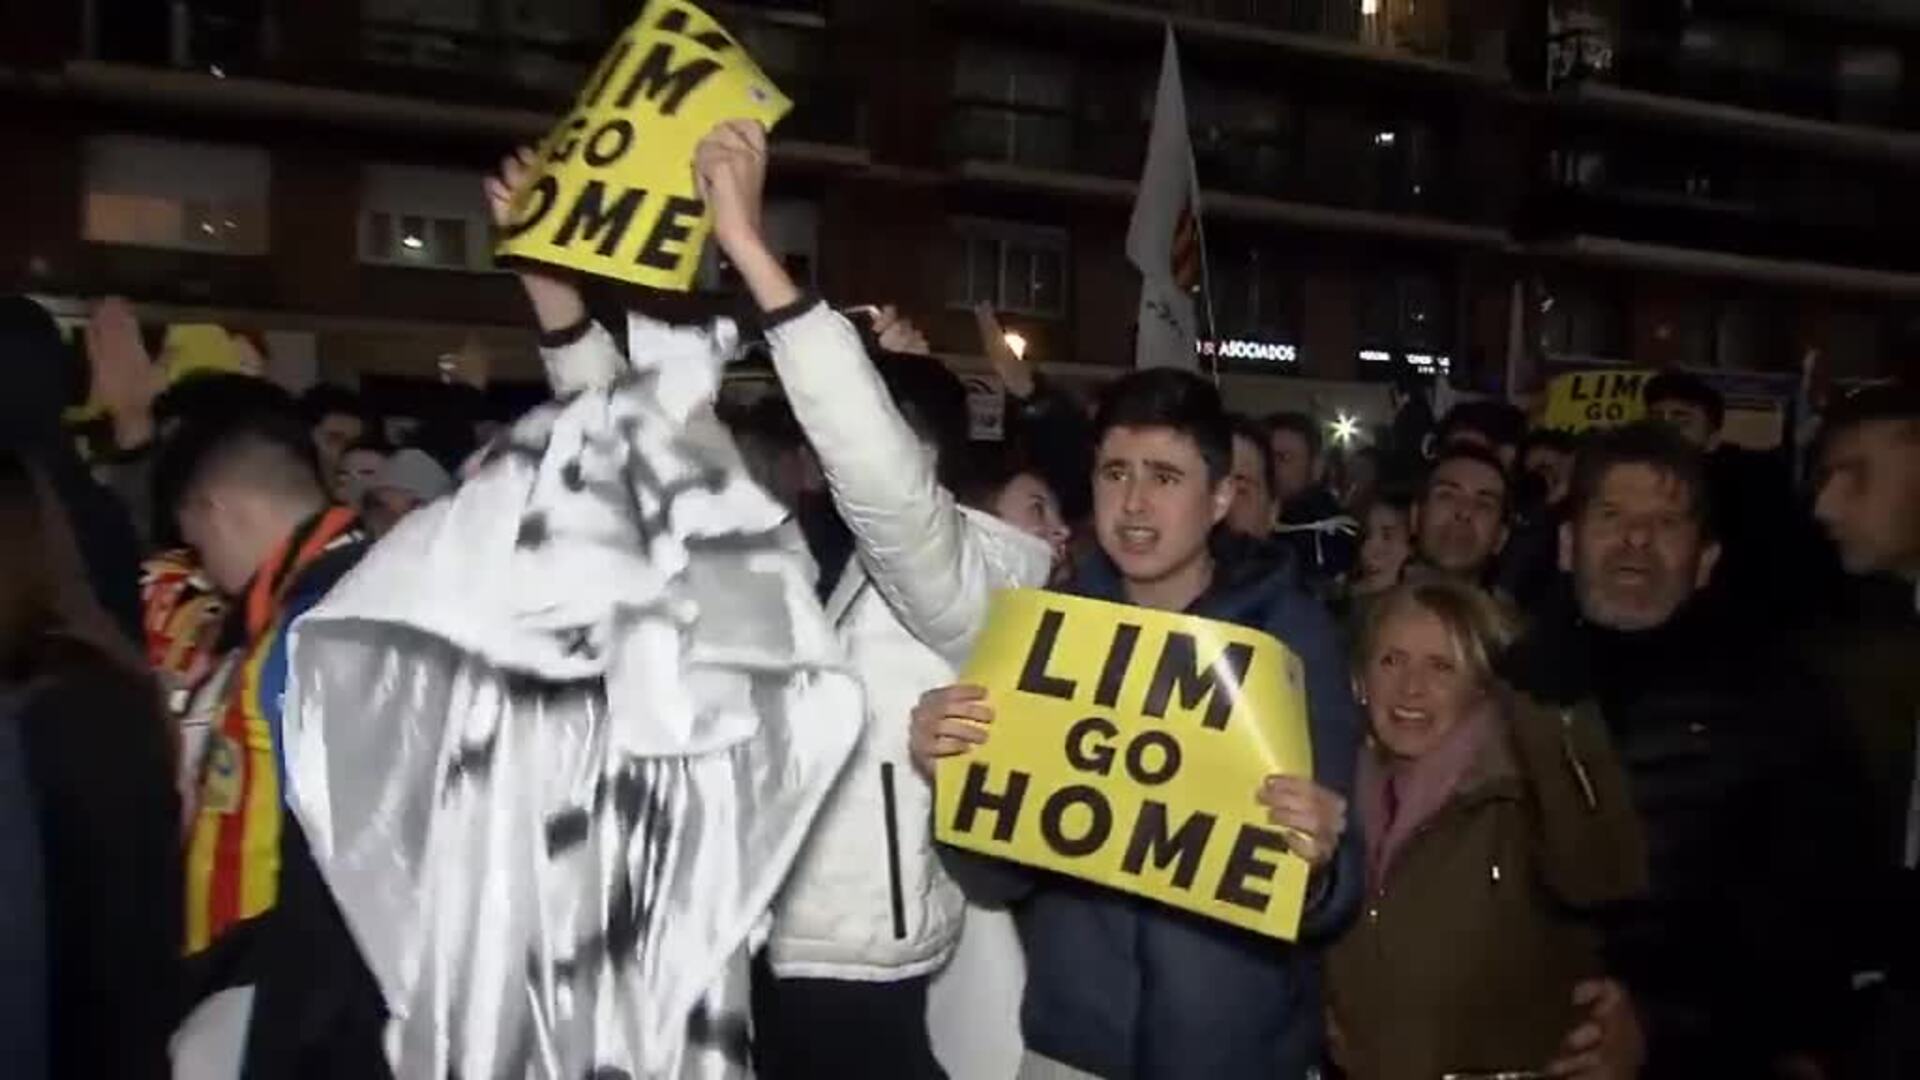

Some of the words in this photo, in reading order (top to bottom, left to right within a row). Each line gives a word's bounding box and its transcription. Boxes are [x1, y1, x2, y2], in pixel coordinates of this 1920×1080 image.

[585, 40, 724, 117] IM
[494, 175, 705, 271] OME
[1218, 339, 1296, 362] ASOCIADOS
[1570, 374, 1643, 401] LIM
[1585, 402, 1625, 421] GO
[1016, 608, 1255, 731] LIM
[1064, 716, 1182, 786] GO
[952, 761, 1290, 913] HOME
